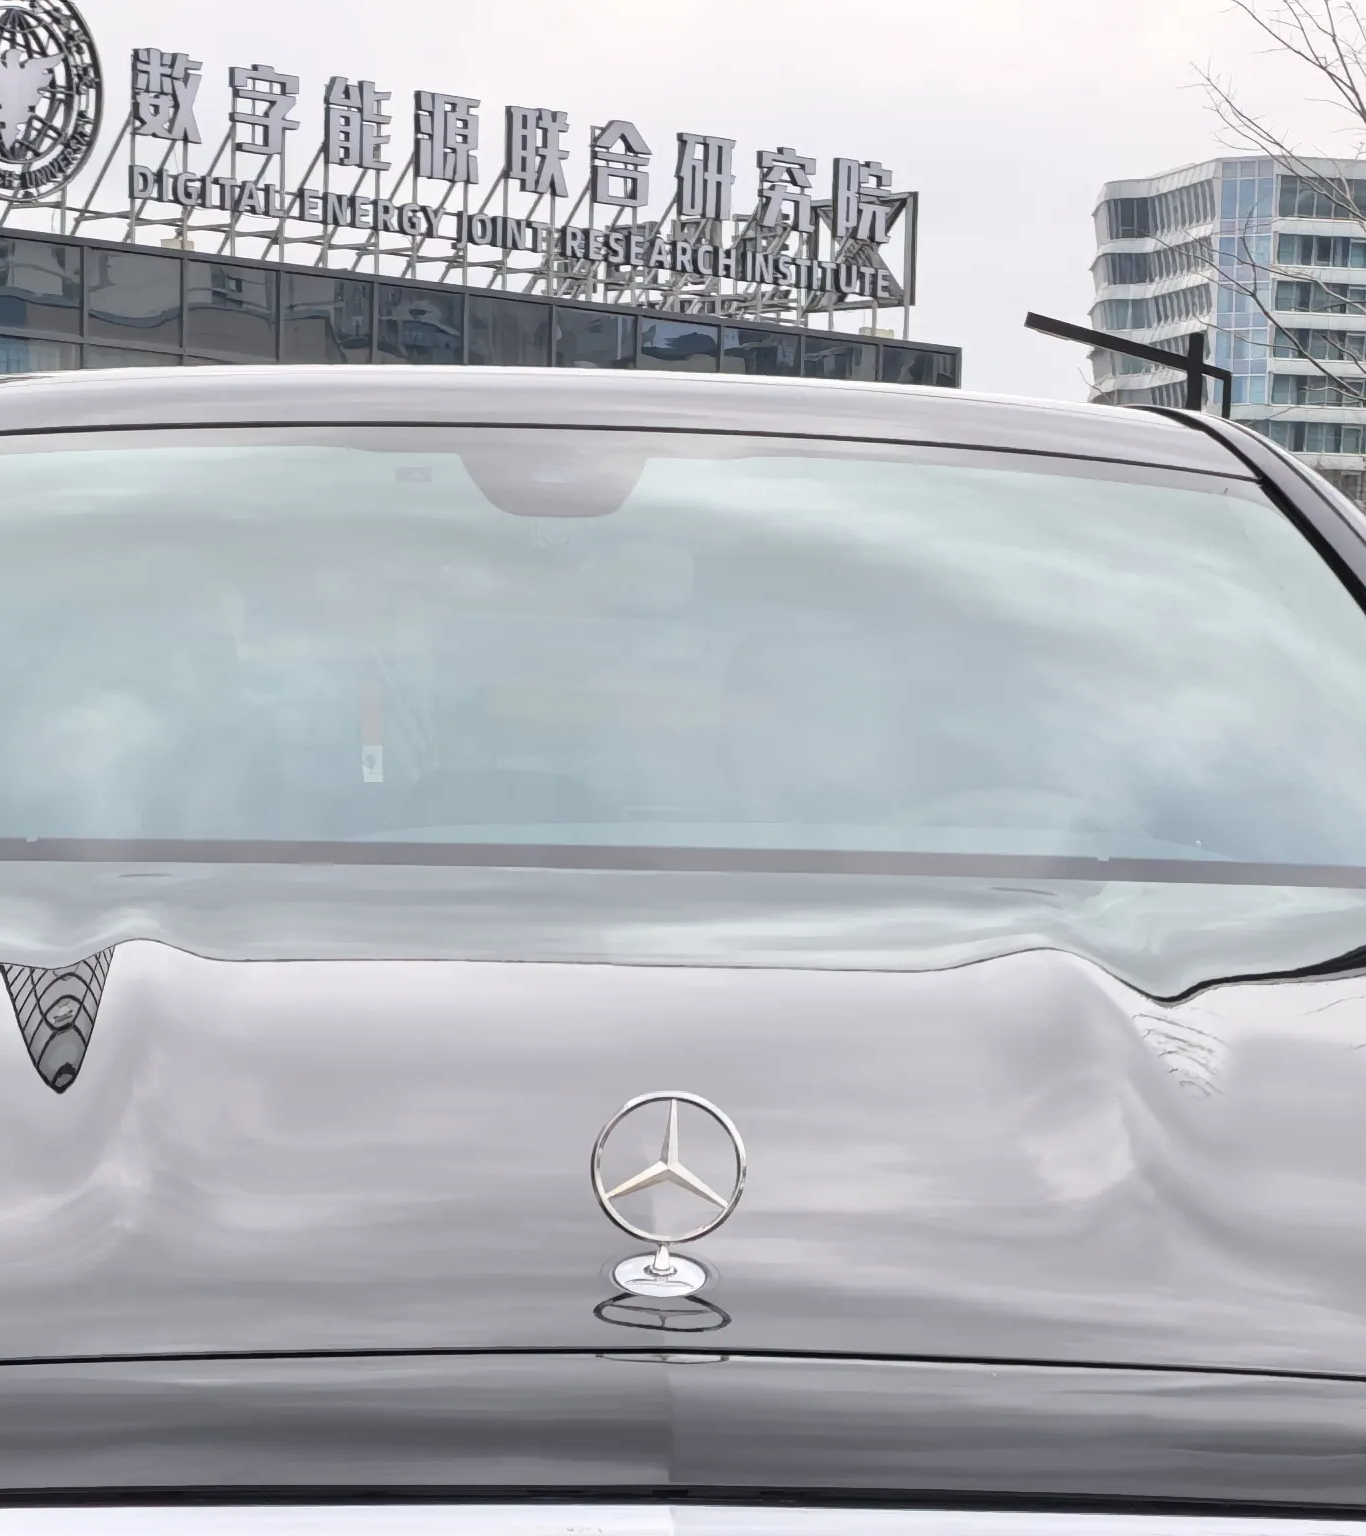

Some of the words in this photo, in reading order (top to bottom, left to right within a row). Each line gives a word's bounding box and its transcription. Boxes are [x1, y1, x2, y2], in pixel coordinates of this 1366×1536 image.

[132, 48, 893, 243] 数字能源联合研究院
[129, 165, 285, 217] DIGITAL
[299, 188, 445, 237] ENERGY
[456, 211, 552, 252] JOINT
[563, 226, 733, 277] RESEARCH
[745, 250, 892, 298] INSTITUTE
